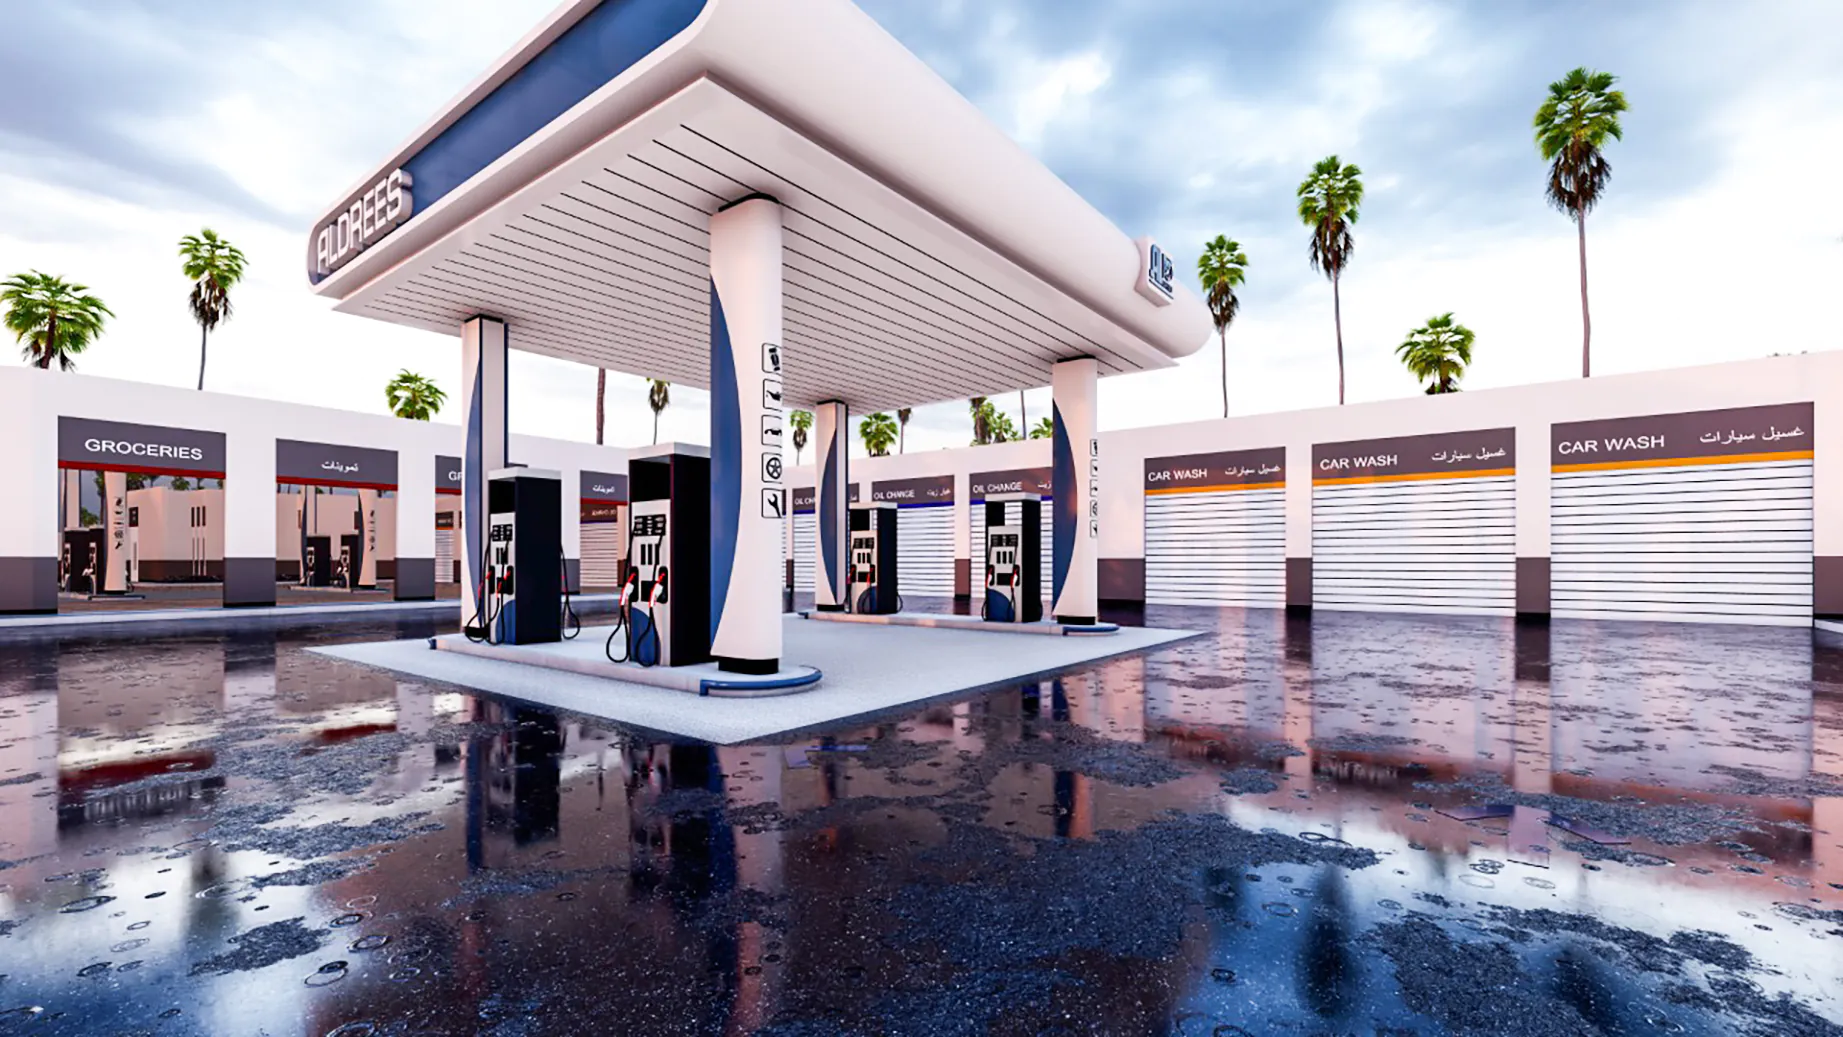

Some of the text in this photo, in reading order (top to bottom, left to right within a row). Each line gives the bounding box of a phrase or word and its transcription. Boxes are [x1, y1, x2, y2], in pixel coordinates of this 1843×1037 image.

[317, 168, 403, 274] ALDREES
[1699, 426, 1805, 445] غسيل سيارات
[84, 438, 203, 461] GROCERIES
[1558, 435, 1665, 455] CAR WASH
[1319, 455, 1398, 471] CAR WASH
[1431, 447, 1507, 464] غسيل سيارات
[1148, 468, 1208, 481] CAR WASH
[972, 481, 1023, 493] OIL CHANGE
